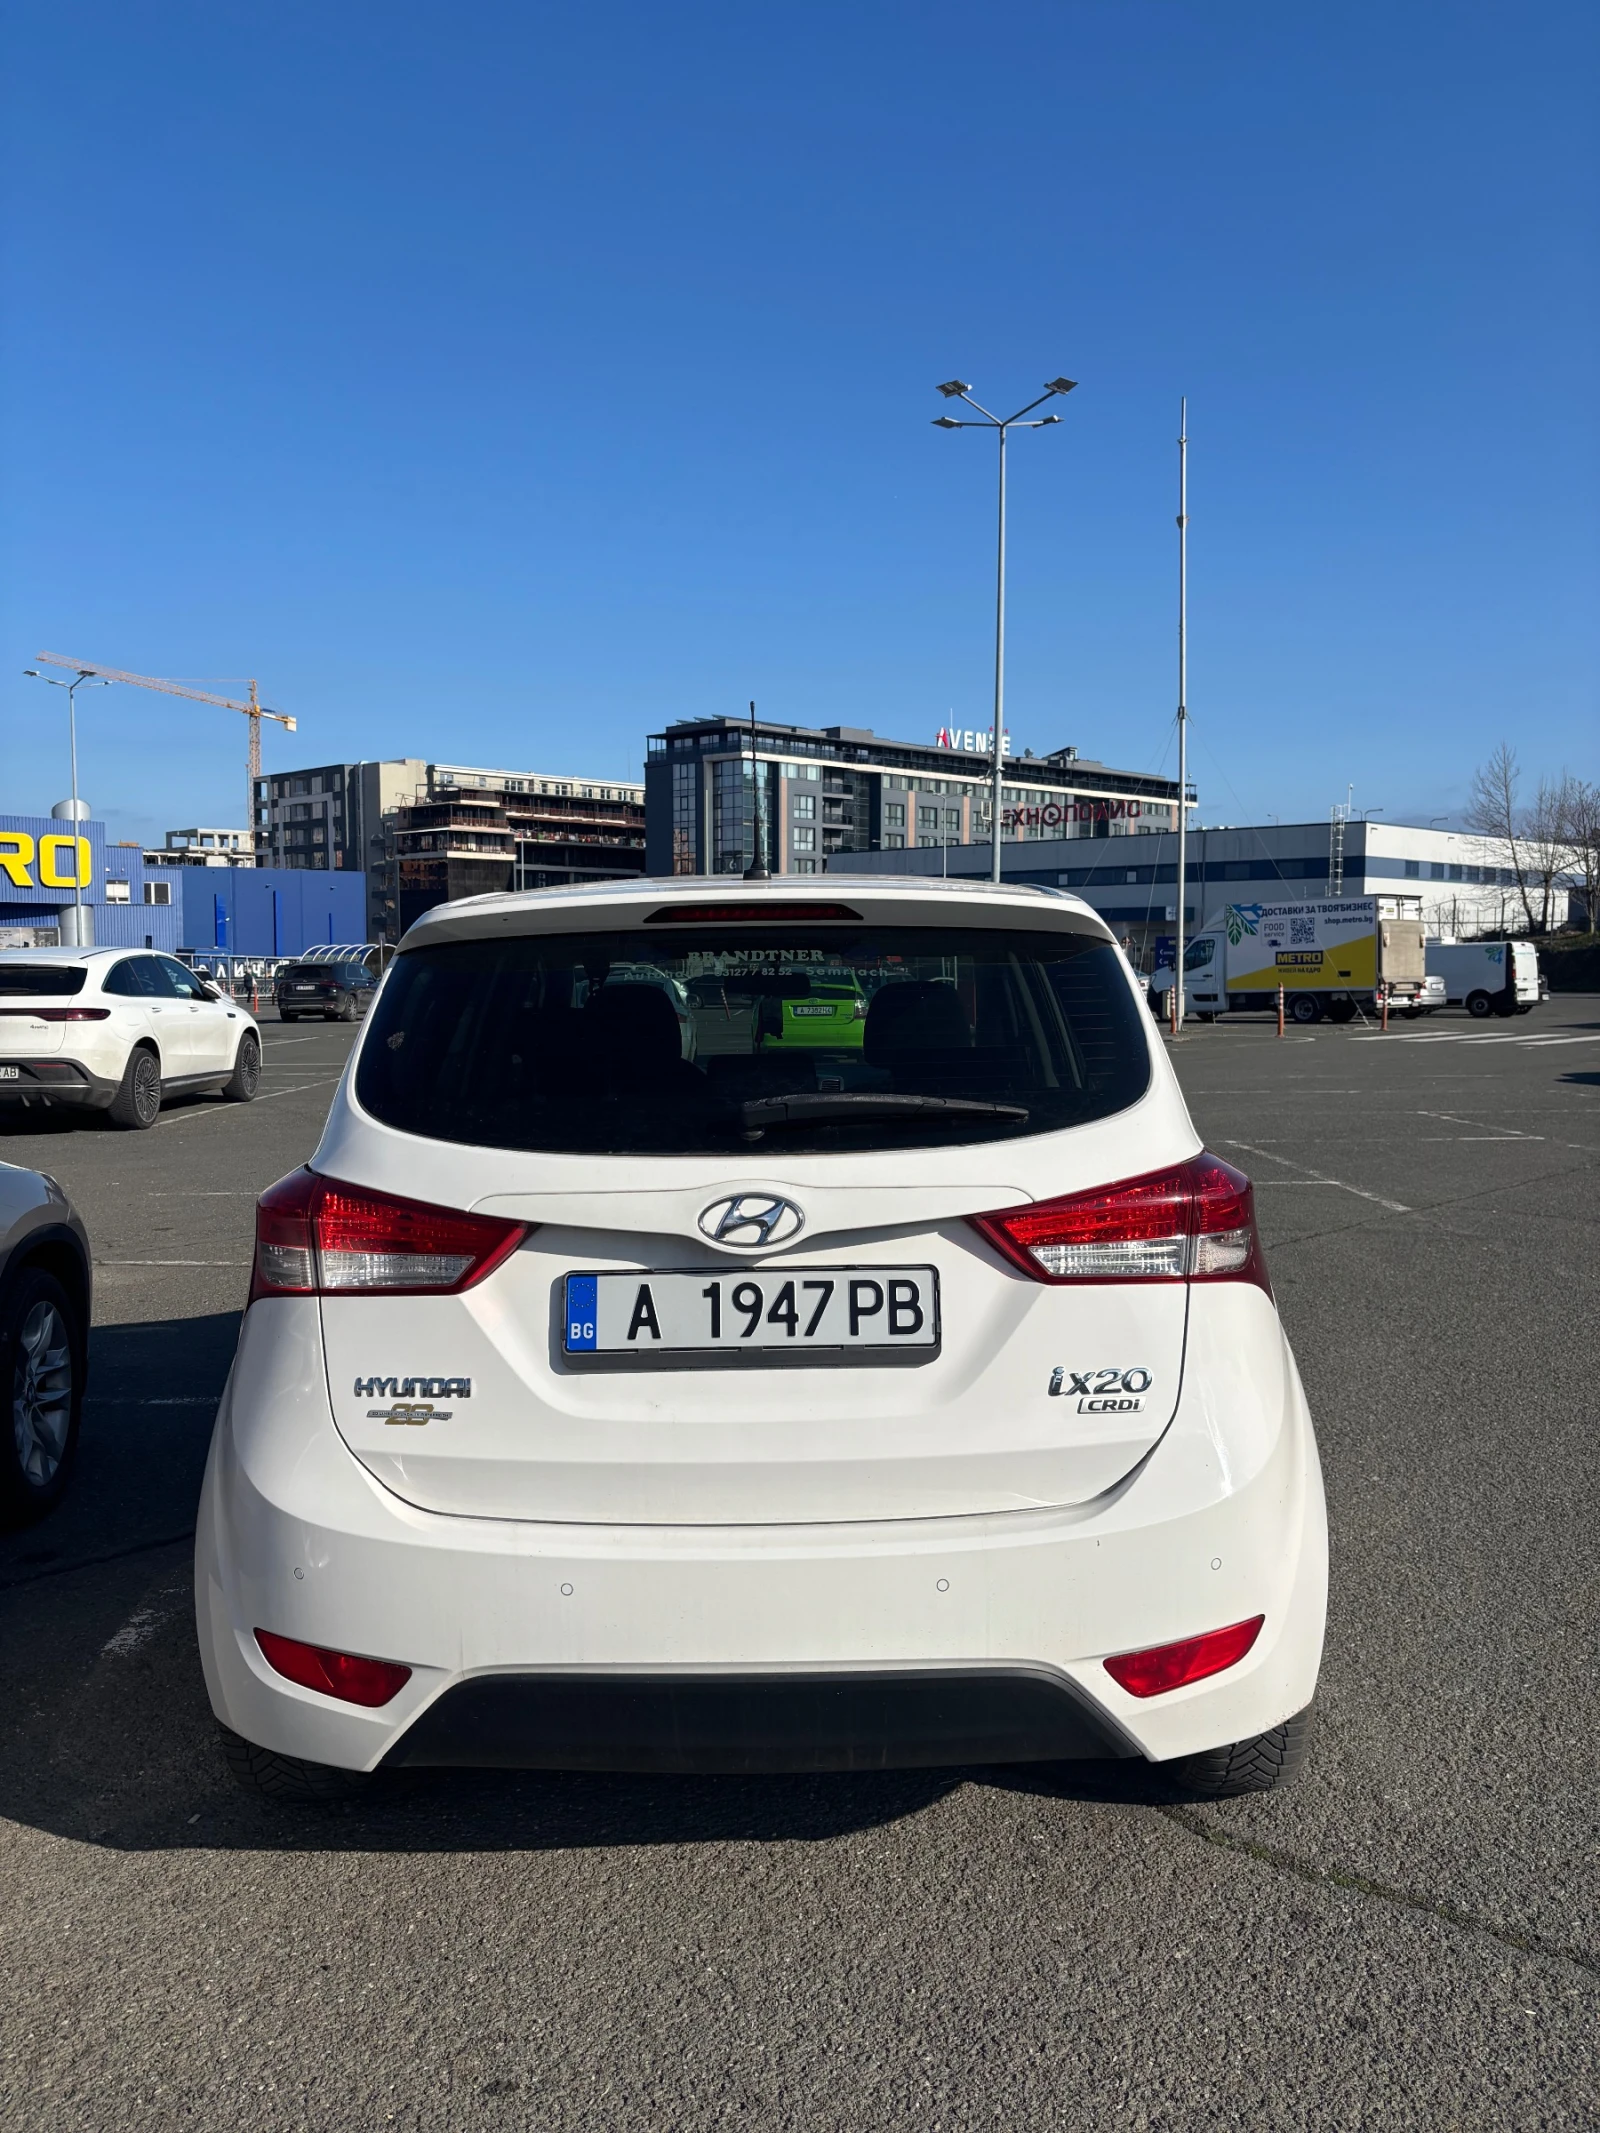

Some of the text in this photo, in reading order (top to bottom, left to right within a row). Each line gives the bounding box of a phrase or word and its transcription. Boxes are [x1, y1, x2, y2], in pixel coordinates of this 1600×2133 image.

[1001, 799, 1143, 827] ЕХНОПОЛИС
[1261, 906, 1304, 917] ДОСТАВКИ
[1306, 905, 1316, 914] ЗА
[1338, 902, 1373, 912] БИЗНЕС
[1263, 923, 1285, 931] FOOD
[1324, 915, 1373, 925] shop.metro.bg
[687, 949, 825, 962] BRANDTNER
[1276, 952, 1322, 964] METRO
[761, 967, 775, 977] 82
[778, 967, 793, 977] 52
[805, 966, 888, 978] Semriach
[626, 1279, 924, 1341] A 1947 PB
[570, 1322, 594, 1340] BG
[354, 1376, 471, 1398] HYUNDAI
[1048, 1366, 1153, 1397] ix20
[1087, 1399, 1141, 1412] CRDi
